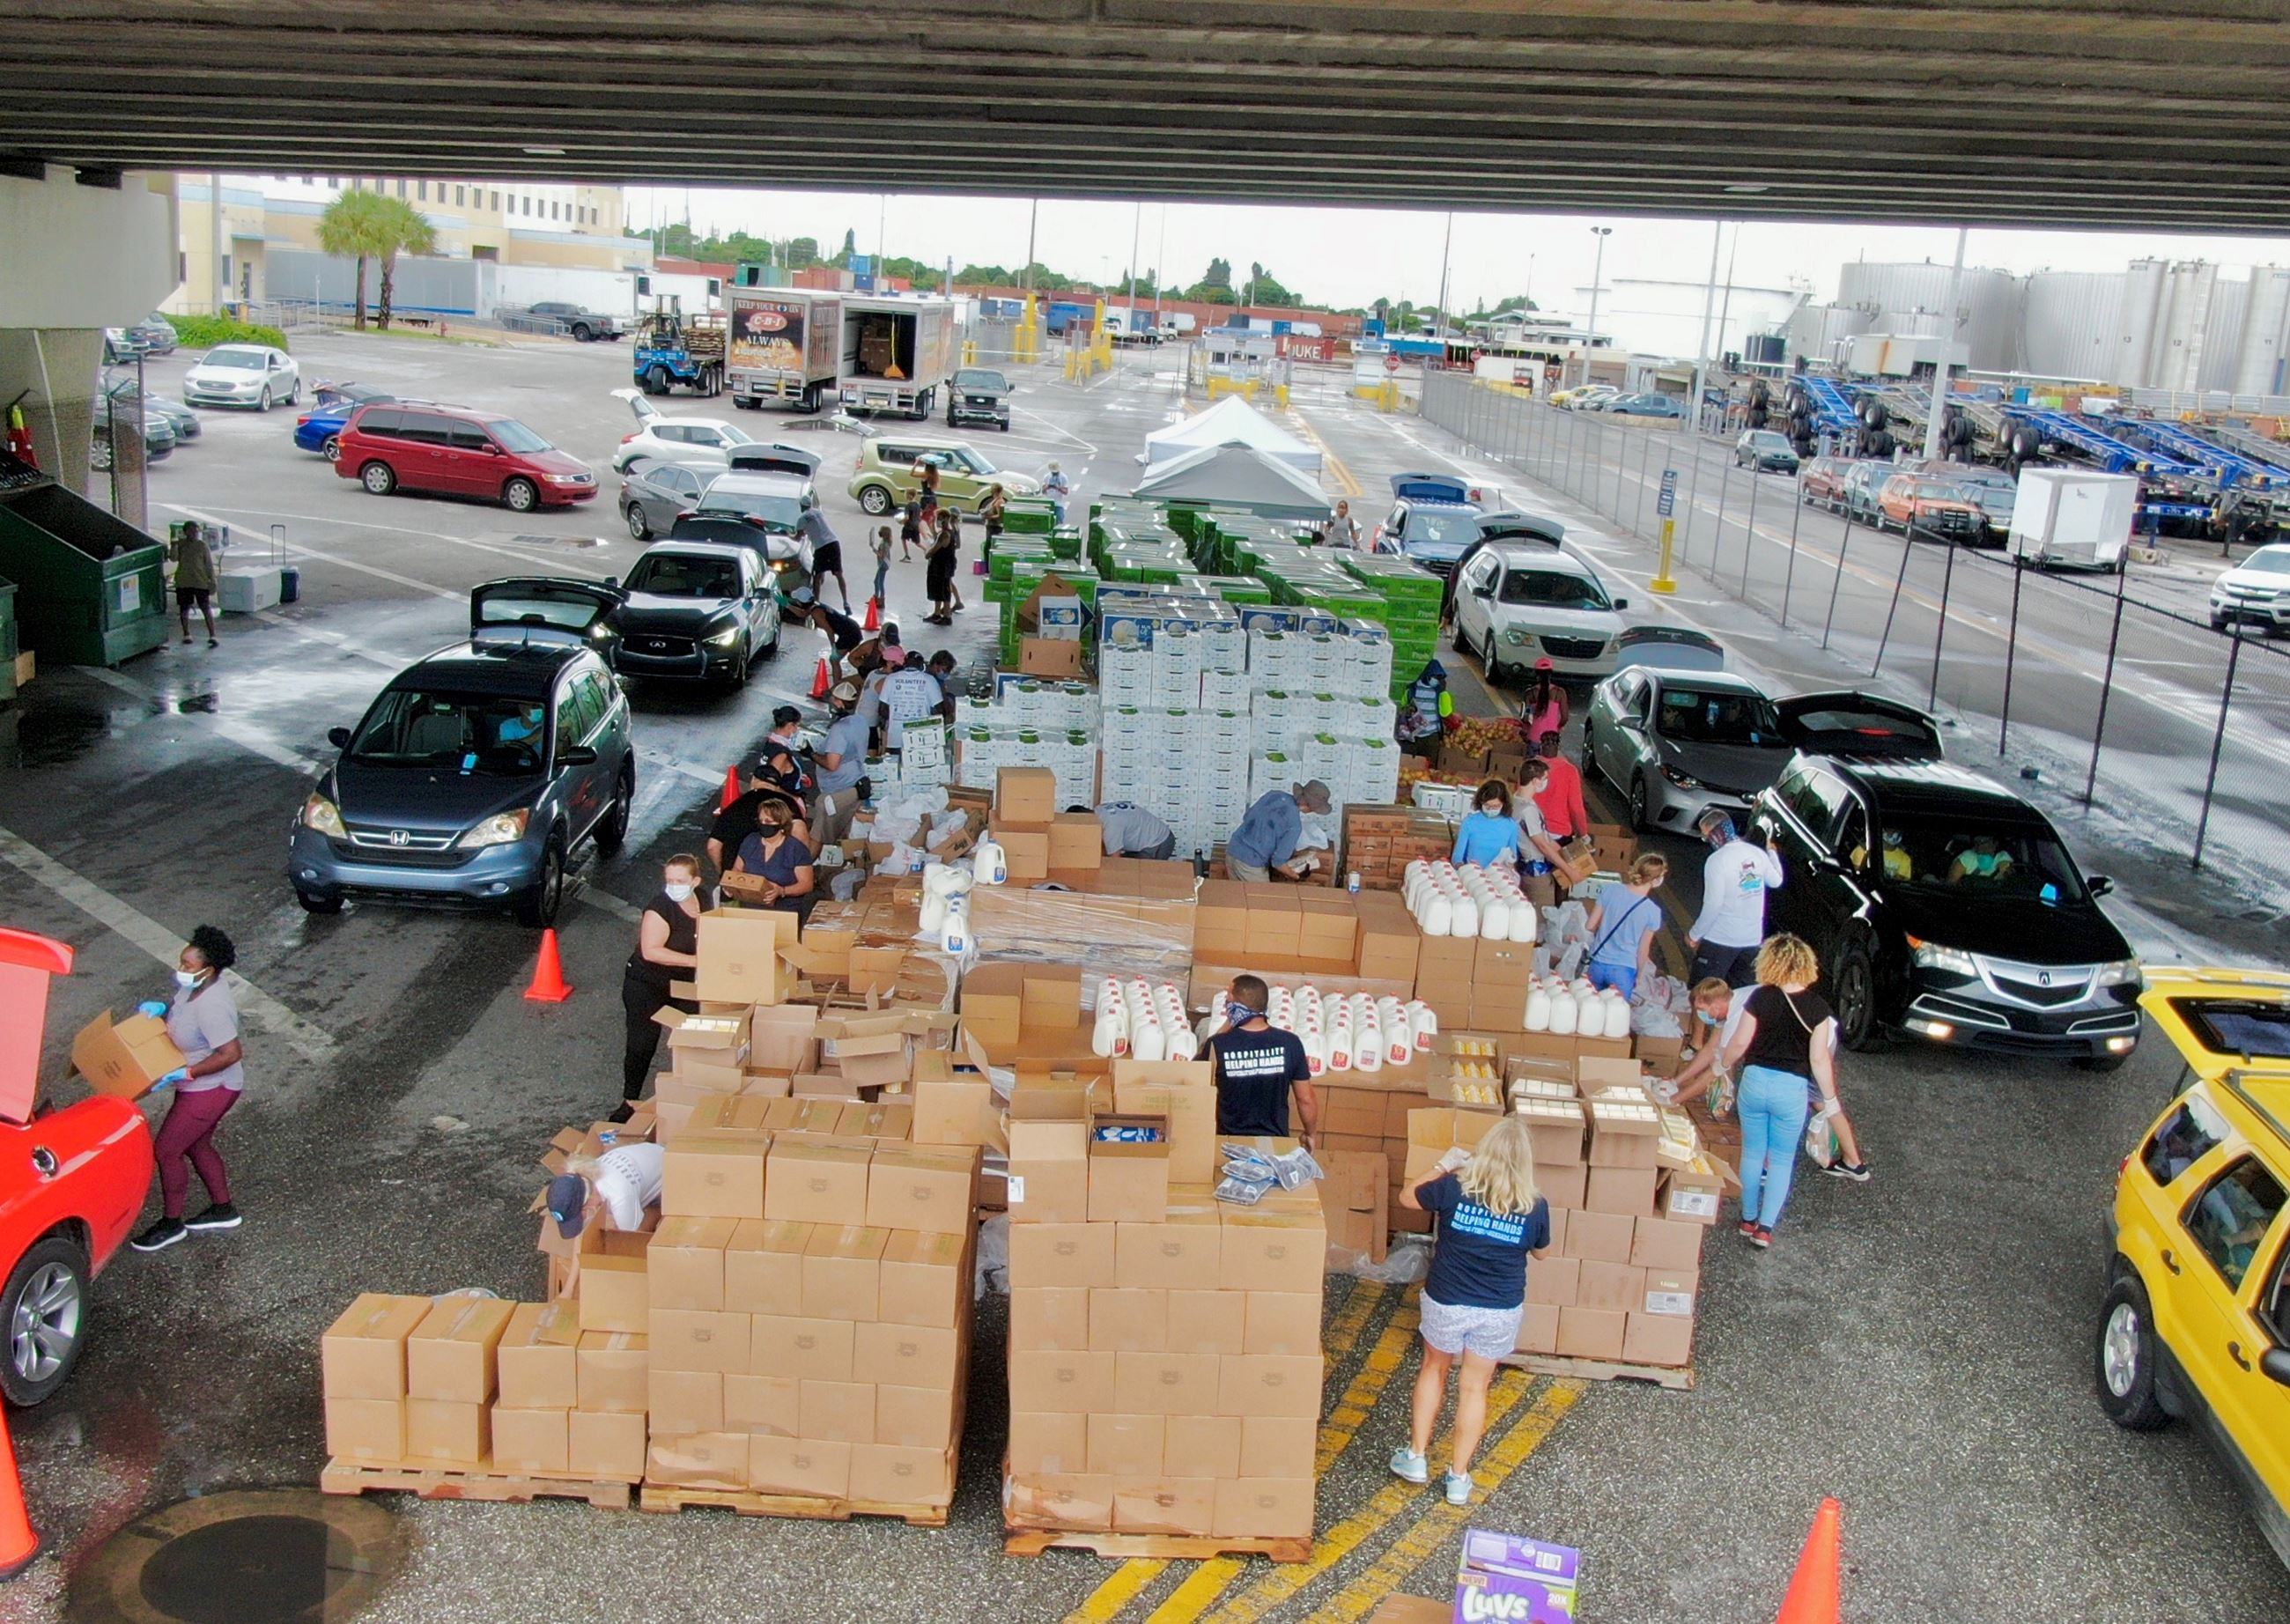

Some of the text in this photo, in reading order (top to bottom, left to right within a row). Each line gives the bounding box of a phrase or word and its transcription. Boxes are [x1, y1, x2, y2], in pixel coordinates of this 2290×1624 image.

[737, 299, 756, 310] KEEP
[756, 302, 775, 312] YOUR
[1223, 1046, 1285, 1060] HOSPITALITY
[1224, 1056, 1285, 1070] HELPING HANDS
[1453, 1211, 1490, 1229] HELPING
[1491, 1220, 1524, 1236] HANDS
[1462, 1575, 1486, 1587] NEW!
[1548, 1592, 1568, 1605] 20X
